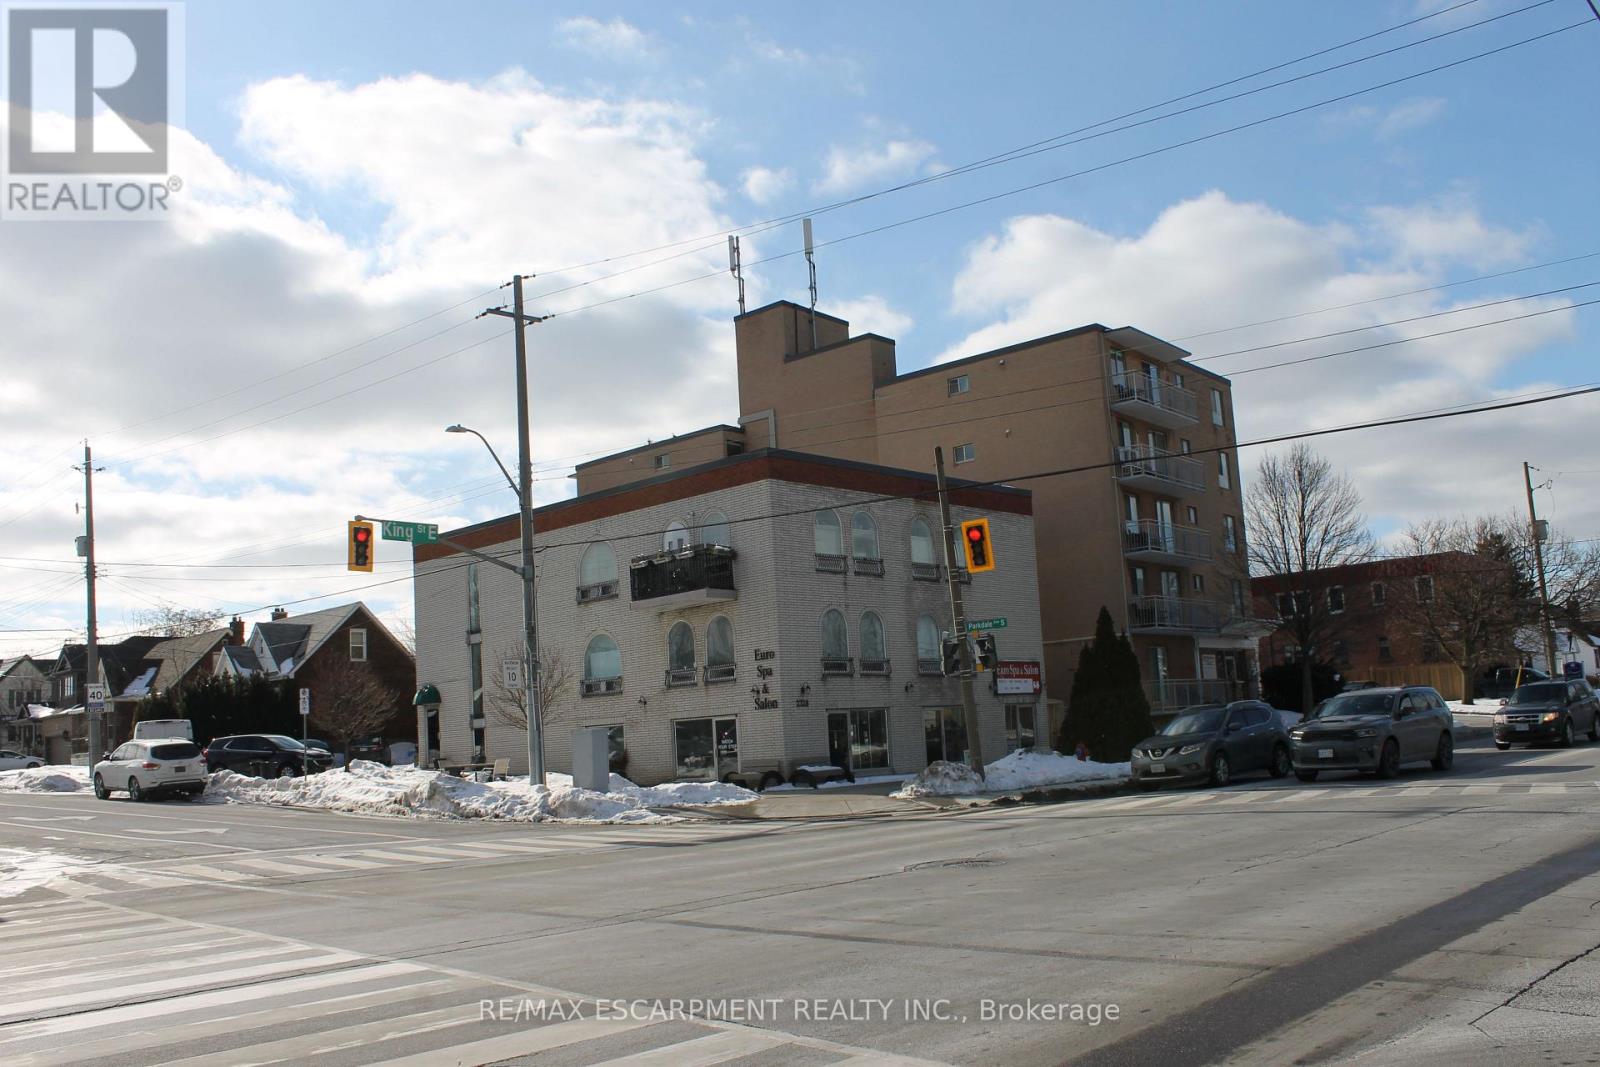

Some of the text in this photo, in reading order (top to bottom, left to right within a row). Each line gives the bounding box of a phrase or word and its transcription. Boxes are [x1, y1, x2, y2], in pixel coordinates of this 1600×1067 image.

[383, 522, 437, 541] King St E
[968, 621, 993, 630] Parkdale
[754, 649, 775, 660] Euro
[508, 671, 517, 682] 10
[757, 665, 773, 680] Spa
[1009, 664, 1019, 677] Spa
[1023, 664, 1039, 675] Salon
[89, 691, 102, 700] 40
[754, 697, 778, 710] Salon
